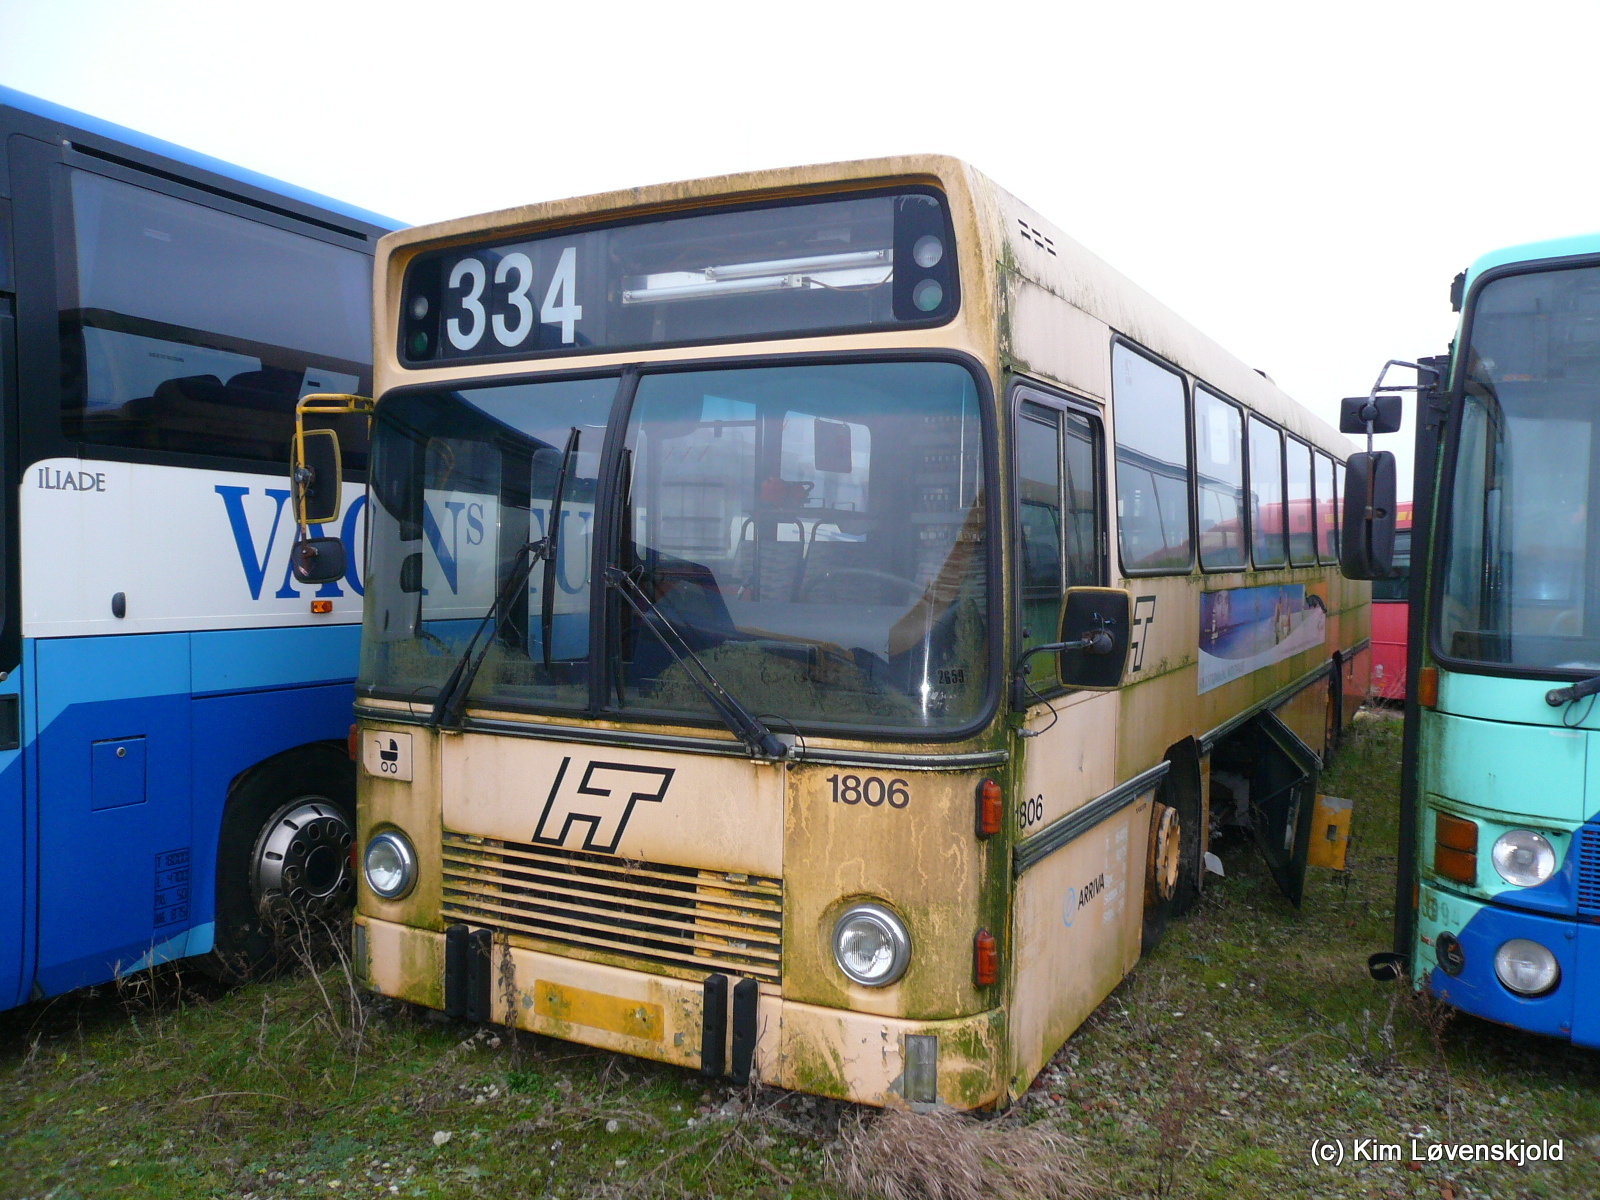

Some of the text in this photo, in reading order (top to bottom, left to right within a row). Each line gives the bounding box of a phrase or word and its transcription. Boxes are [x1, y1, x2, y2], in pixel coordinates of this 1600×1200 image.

[447, 247, 582, 351] 334
[38, 467, 106, 492] ILIADE
[938, 669, 965, 684] 2659
[532, 756, 676, 854] HT
[826, 774, 910, 809] 1806
[1077, 872, 1105, 911] ARRIVA
